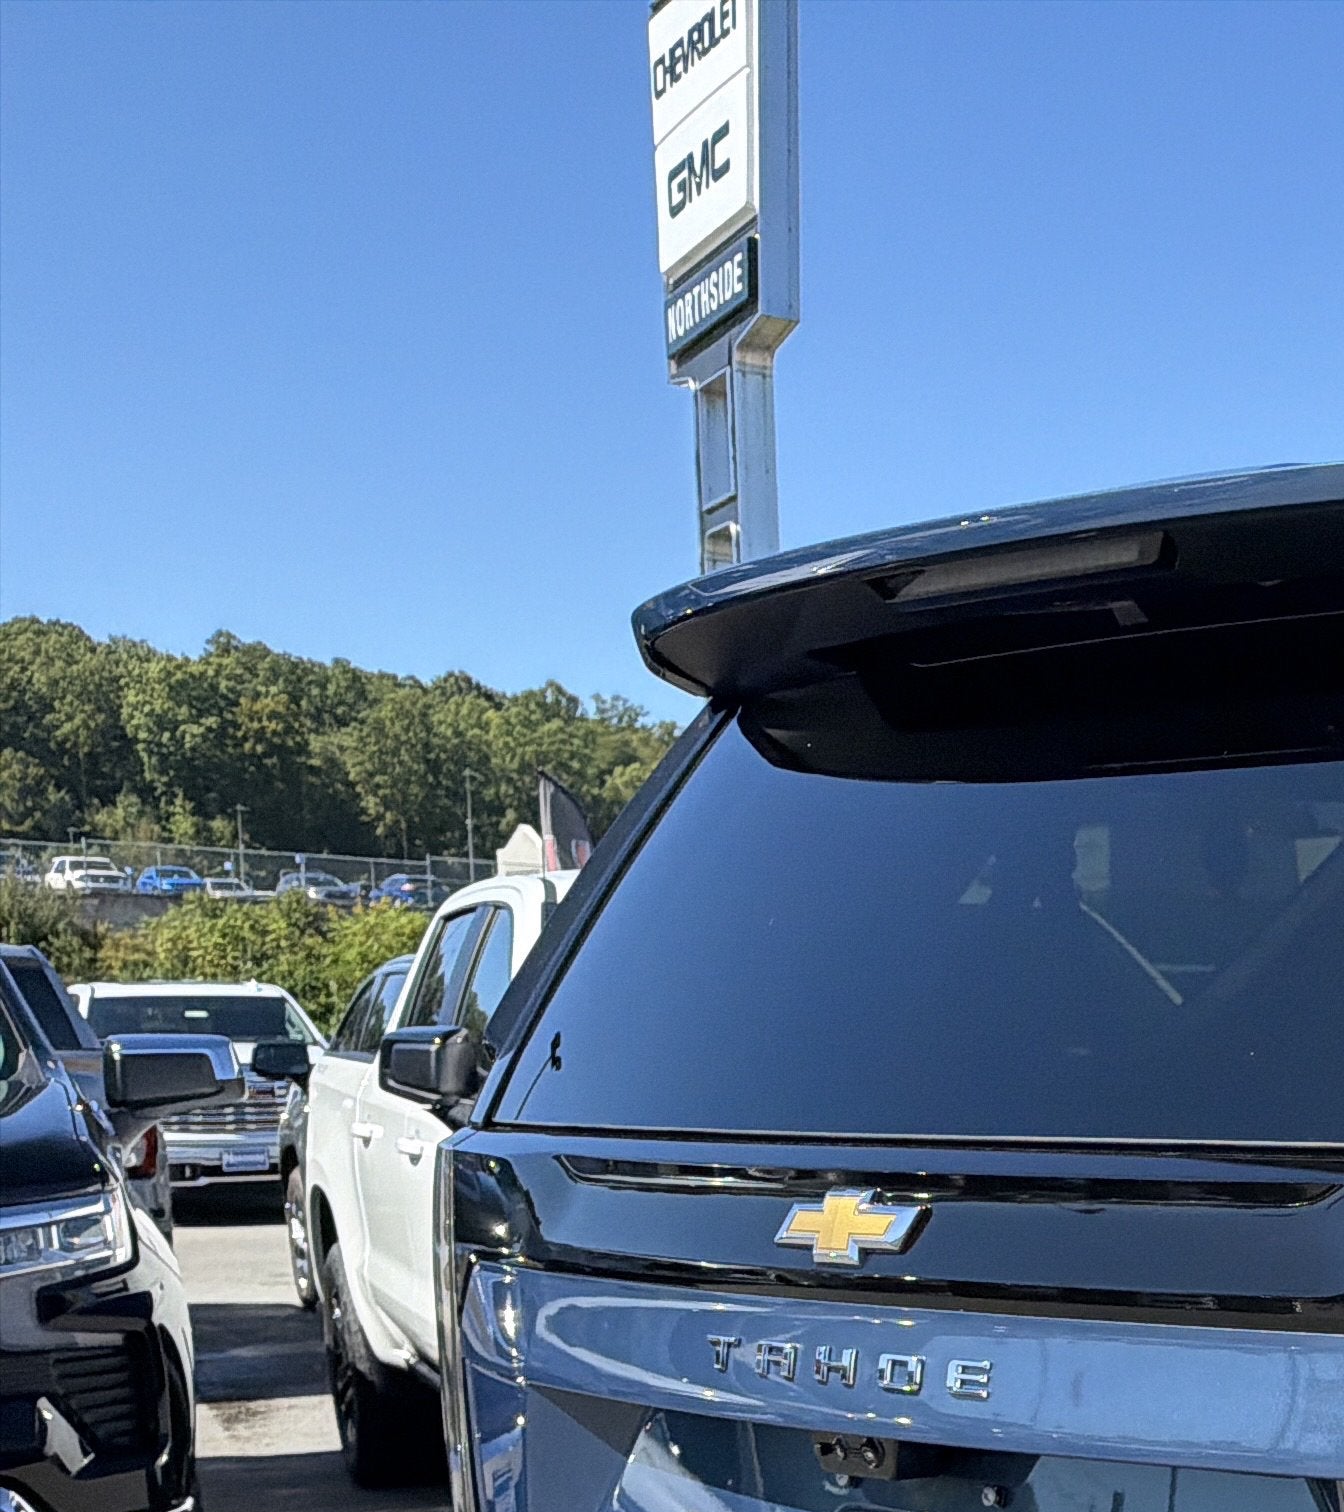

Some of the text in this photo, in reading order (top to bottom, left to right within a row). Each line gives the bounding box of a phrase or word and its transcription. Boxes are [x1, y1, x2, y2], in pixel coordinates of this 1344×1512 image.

[653, 0, 736, 100] CHEVROLET
[667, 119, 730, 219] GMC
[667, 252, 743, 344] NORTHSIDE
[706, 1333, 993, 1400] TAHOE
